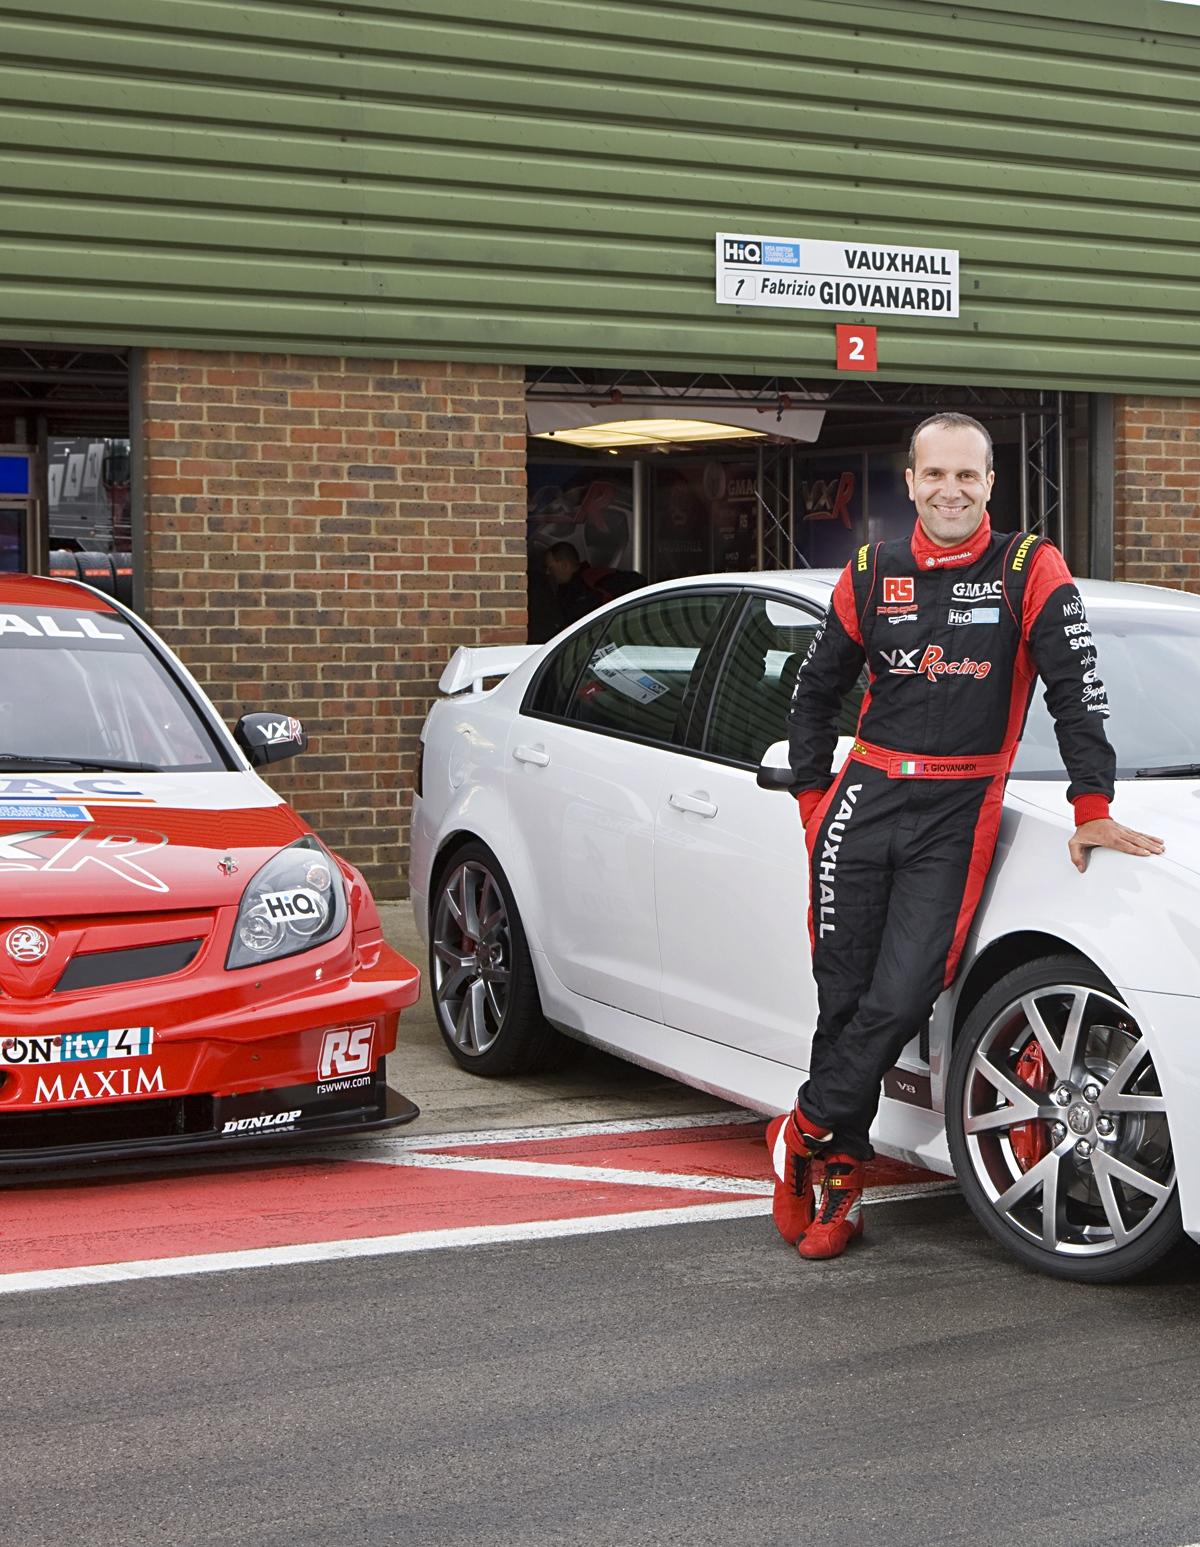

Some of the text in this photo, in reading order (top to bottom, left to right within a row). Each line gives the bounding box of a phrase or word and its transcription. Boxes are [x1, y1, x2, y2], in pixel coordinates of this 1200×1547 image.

[725, 241, 761, 263] HiQ
[844, 249, 951, 276] VAUXHALL
[735, 277, 951, 312] 1 Fabrizio GIOVANARDI
[849, 336, 865, 361] 2
[936, 551, 972, 564] VAUXHALL
[1013, 534, 1038, 572] momo
[884, 578, 914, 602] RS
[952, 580, 1003, 598] GMAC
[949, 611, 972, 625] HiQ
[257, 717, 303, 745] VXR
[930, 763, 977, 773] GIOVANARDI
[819, 783, 863, 939] VAUXHALL
[265, 893, 316, 919] HiQ
[65, 1034, 105, 1060] itv
[115, 1029, 132, 1056] 4
[321, 1026, 372, 1077] RS
[32, 1064, 167, 1104] MAXIM
[316, 1076, 371, 1095] rswww.com
[895, 1080, 917, 1094] V8
[221, 1109, 302, 1134] DUNLOP
